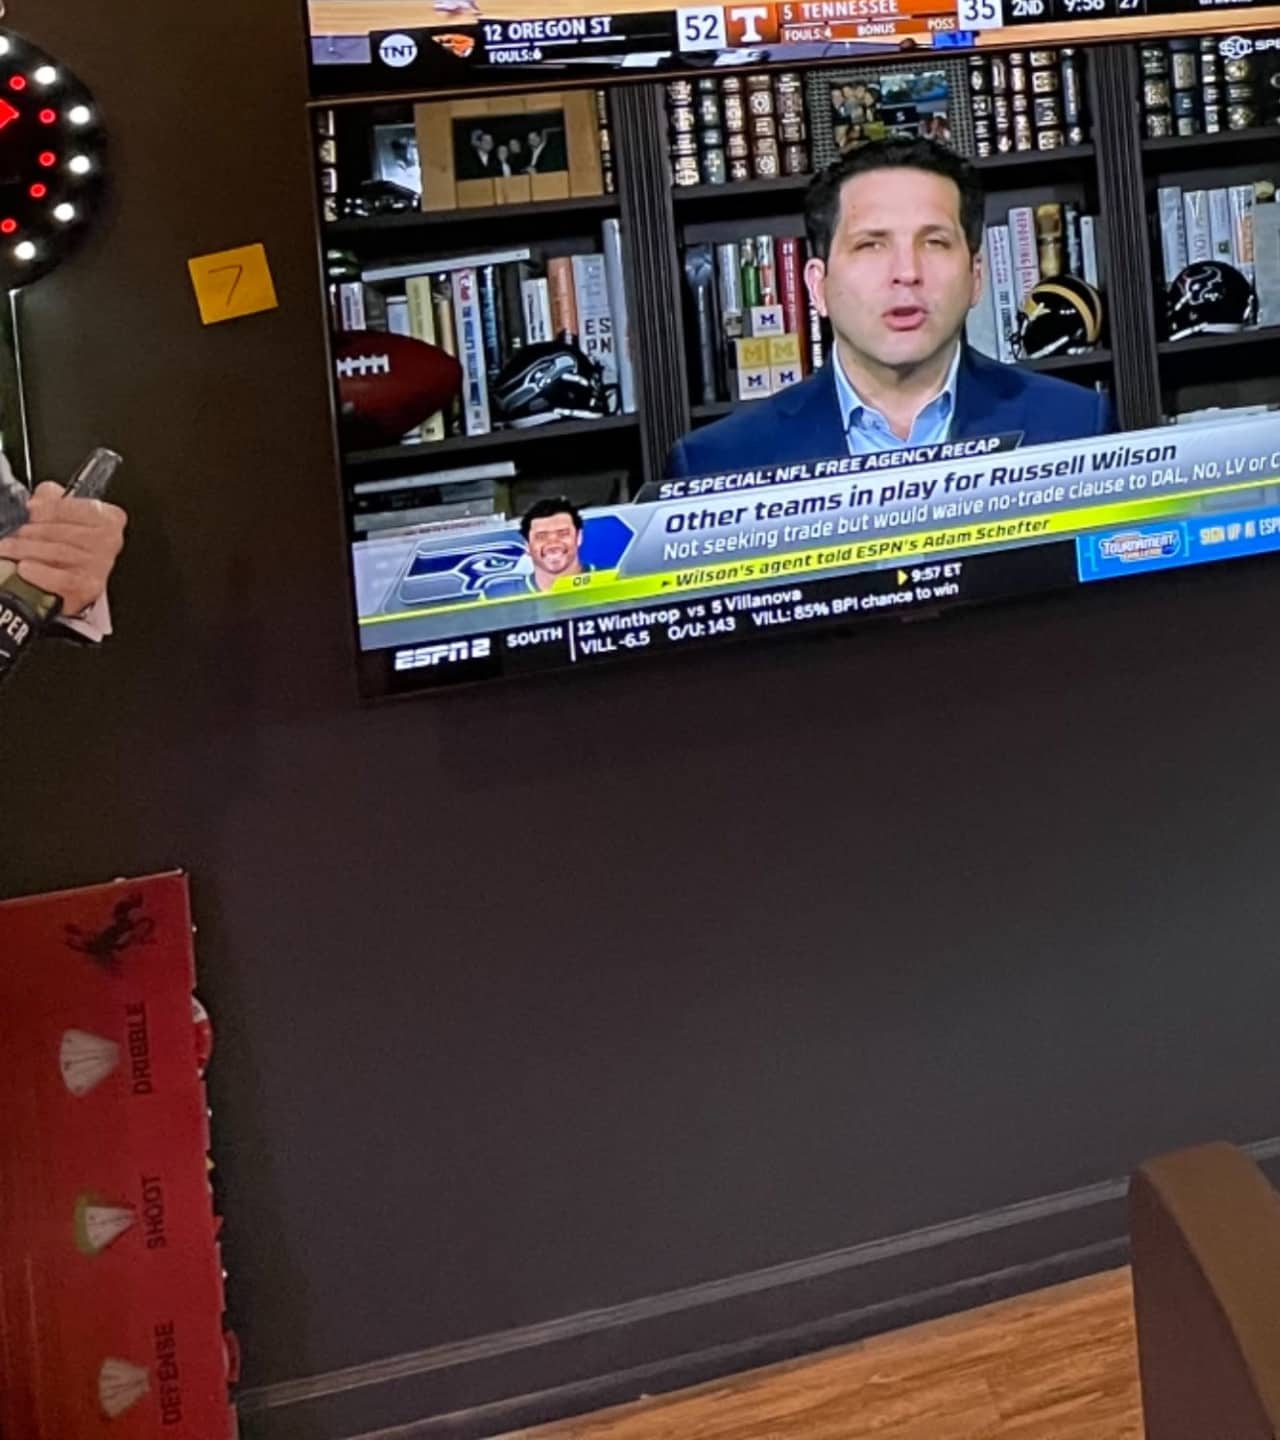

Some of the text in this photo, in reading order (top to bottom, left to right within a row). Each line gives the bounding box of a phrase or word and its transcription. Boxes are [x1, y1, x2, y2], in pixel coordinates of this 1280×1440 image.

[483, 16, 612, 42] 12 OREGON ST
[684, 14, 719, 41] 52
[783, 4, 793, 20] 5
[856, 17, 956, 37] BONUS POSS
[208, 264, 243, 306] 7
[658, 437, 1001, 499] SC SPECIAL: NFL FREE AGENCY RECAP
[665, 444, 1178, 535] Other teams in play for Russell Wilson
[663, 538, 699, 561] Not
[703, 524, 779, 557] seeking
[783, 517, 834, 544] trade
[838, 511, 870, 536] but
[873, 501, 929, 531] would
[932, 496, 985, 521] waive
[986, 482, 1066, 513] no-trade
[1068, 476, 1125, 502] clause
[1128, 471, 1148, 490] to
[1150, 465, 1189, 490] DAL,
[1192, 460, 1222, 483] NO,
[1225, 456, 1246, 476] LV
[1248, 453, 1268, 473] or
[674, 517, 1051, 589] Wilson's agent told ESPN's Adam Schefter
[577, 562, 963, 637] 12 Winthrop vs 5 Villanova 9:57 ET
[579, 582, 960, 655] VILL -6.5 O/U: 143 VILL: 85% BPI chance to win
[394, 627, 563, 672] ESPN2 SOUTH
[125, 1001, 152, 1096] DRIBBLE
[141, 1173, 167, 1249] SHOOT
[154, 1317, 181, 1427] DEFENSE
